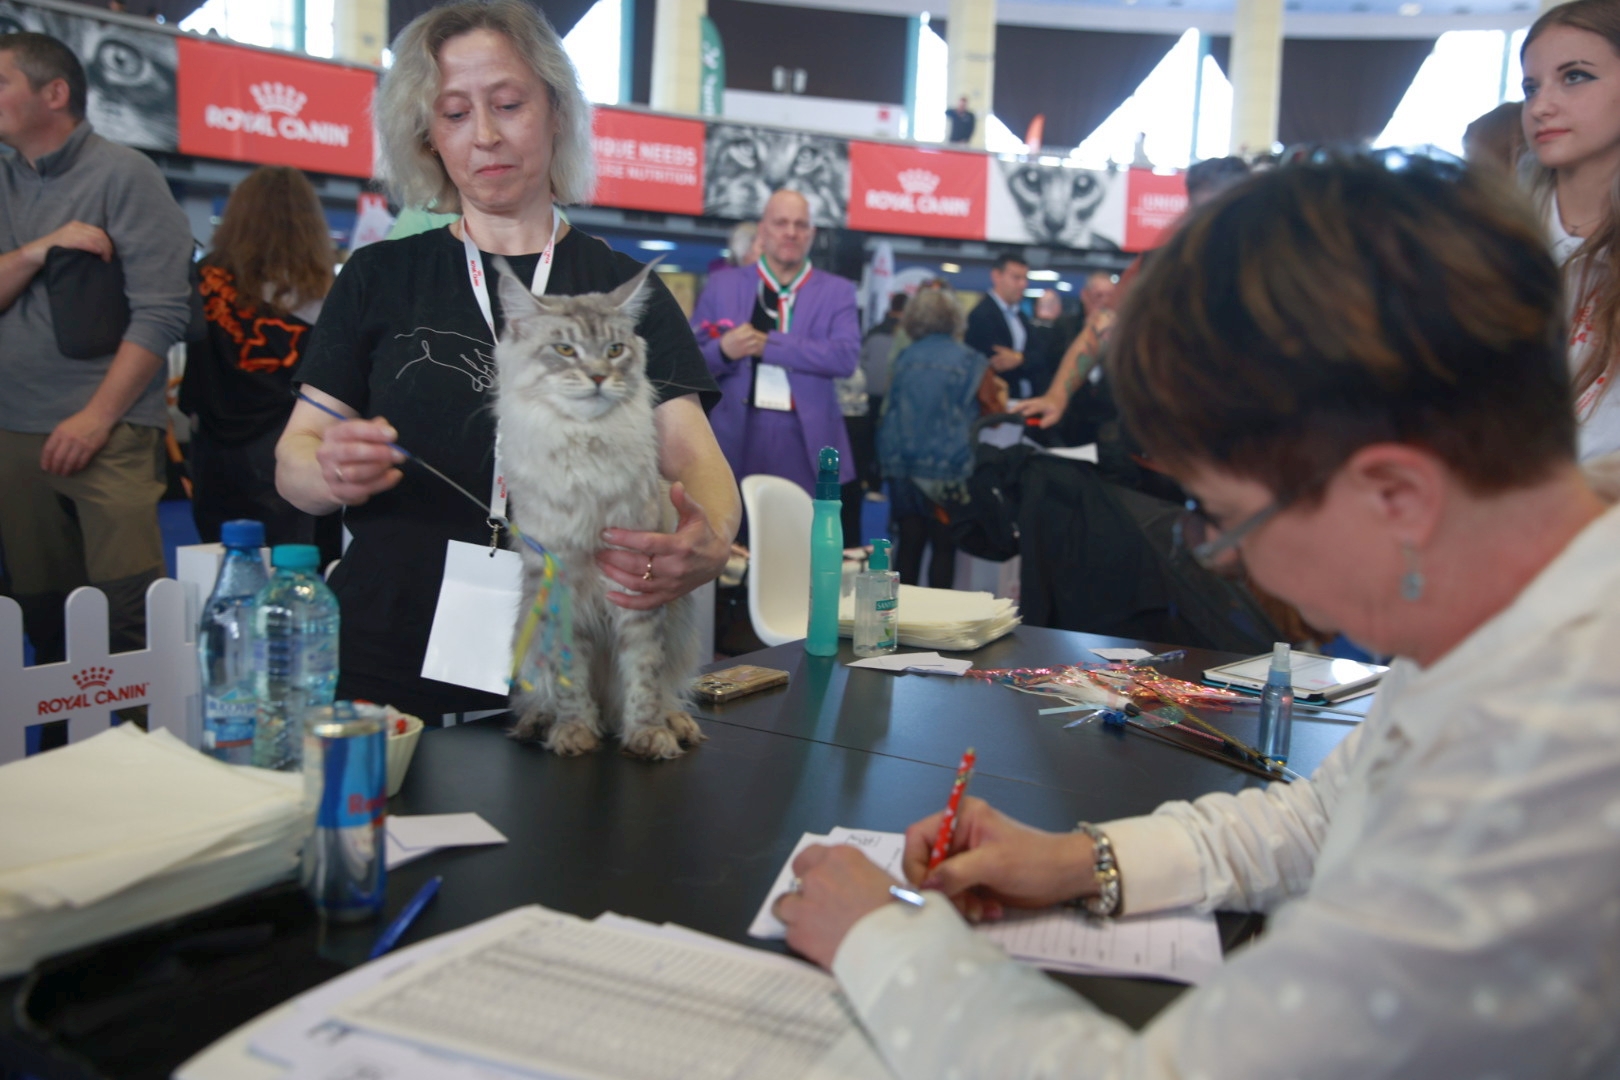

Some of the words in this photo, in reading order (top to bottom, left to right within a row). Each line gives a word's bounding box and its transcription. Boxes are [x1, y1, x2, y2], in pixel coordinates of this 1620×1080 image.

[205, 104, 277, 137] ROYAL
[277, 117, 349, 148] CANIN
[639, 142, 697, 167] NEEDS
[626, 166, 697, 187] NUTRITION
[865, 189, 916, 213] ROYAL
[916, 195, 970, 217] CANIN
[38, 694, 91, 715] ROYAL
[95, 683, 147, 705] CANIN
